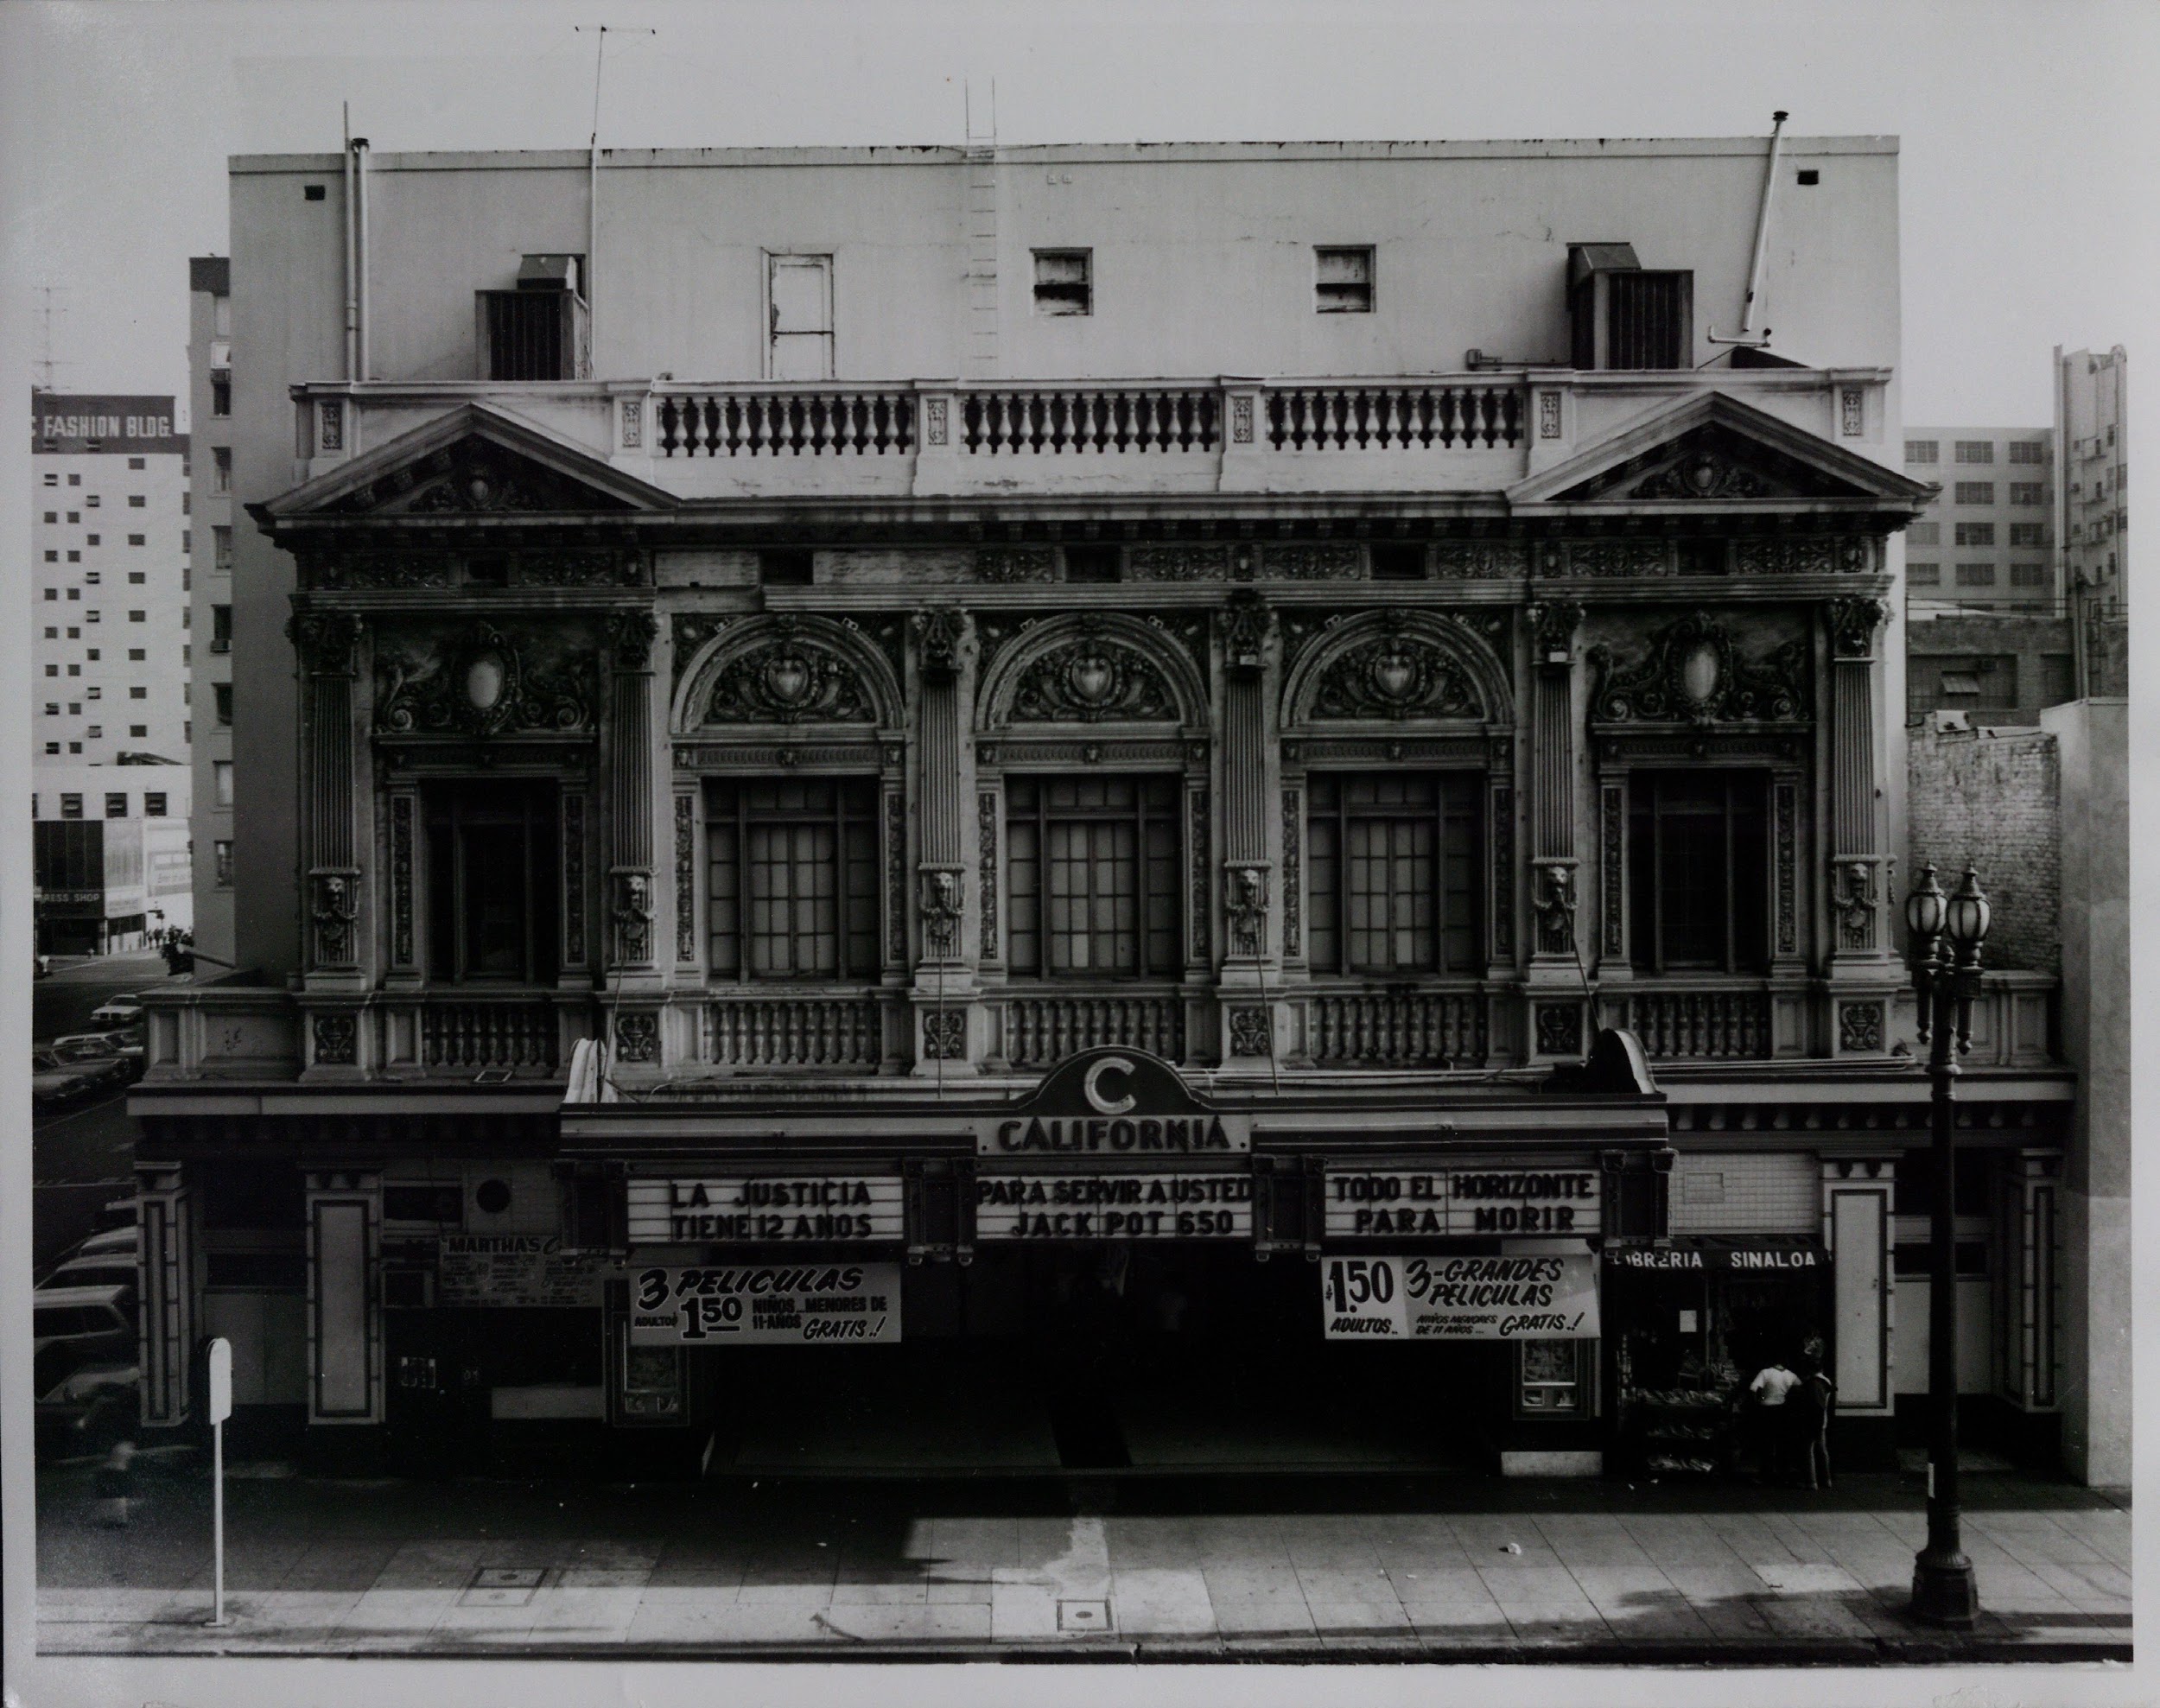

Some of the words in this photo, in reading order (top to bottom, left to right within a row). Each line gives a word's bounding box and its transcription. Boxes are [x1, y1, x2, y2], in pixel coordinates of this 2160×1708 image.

[43, 416, 119, 438] FASHION
[73, 892, 100, 903] SHOP
[1084, 1056, 1137, 1115] C
[997, 1115, 1230, 1152] CALIFORNIA
[671, 1183, 709, 1208] LA
[734, 1181, 872, 1207] JUSTICIA
[977, 1179, 1045, 1204] PARA
[1053, 1178, 1140, 1203] SERVIR
[1147, 1178, 1167, 1203] A
[1172, 1177, 1252, 1203] USTED
[1334, 1176, 1401, 1202] TODO
[1411, 1176, 1441, 1201] EL
[1453, 1173, 1594, 1199] HORIZONTE
[675, 1215, 751, 1239] TIENE
[759, 1215, 784, 1238] 12
[793, 1214, 872, 1238] ANOS
[1013, 1212, 1091, 1236] JACK
[1106, 1211, 1163, 1235] POT
[1178, 1210, 1233, 1235] 650
[1356, 1209, 1440, 1233] PARA
[1475, 1207, 1574, 1231] MORIR
[1731, 1251, 1816, 1268] SINALOA
[638, 1268, 669, 1310] 3
[675, 1267, 864, 1297] PELICULAS
[1427, 1284, 1553, 1307] PELICULAS
[871, 1296, 887, 1311] DE
[1415, 1325, 1432, 1335] DE
[1450, 1314, 1498, 1324] MENORES
